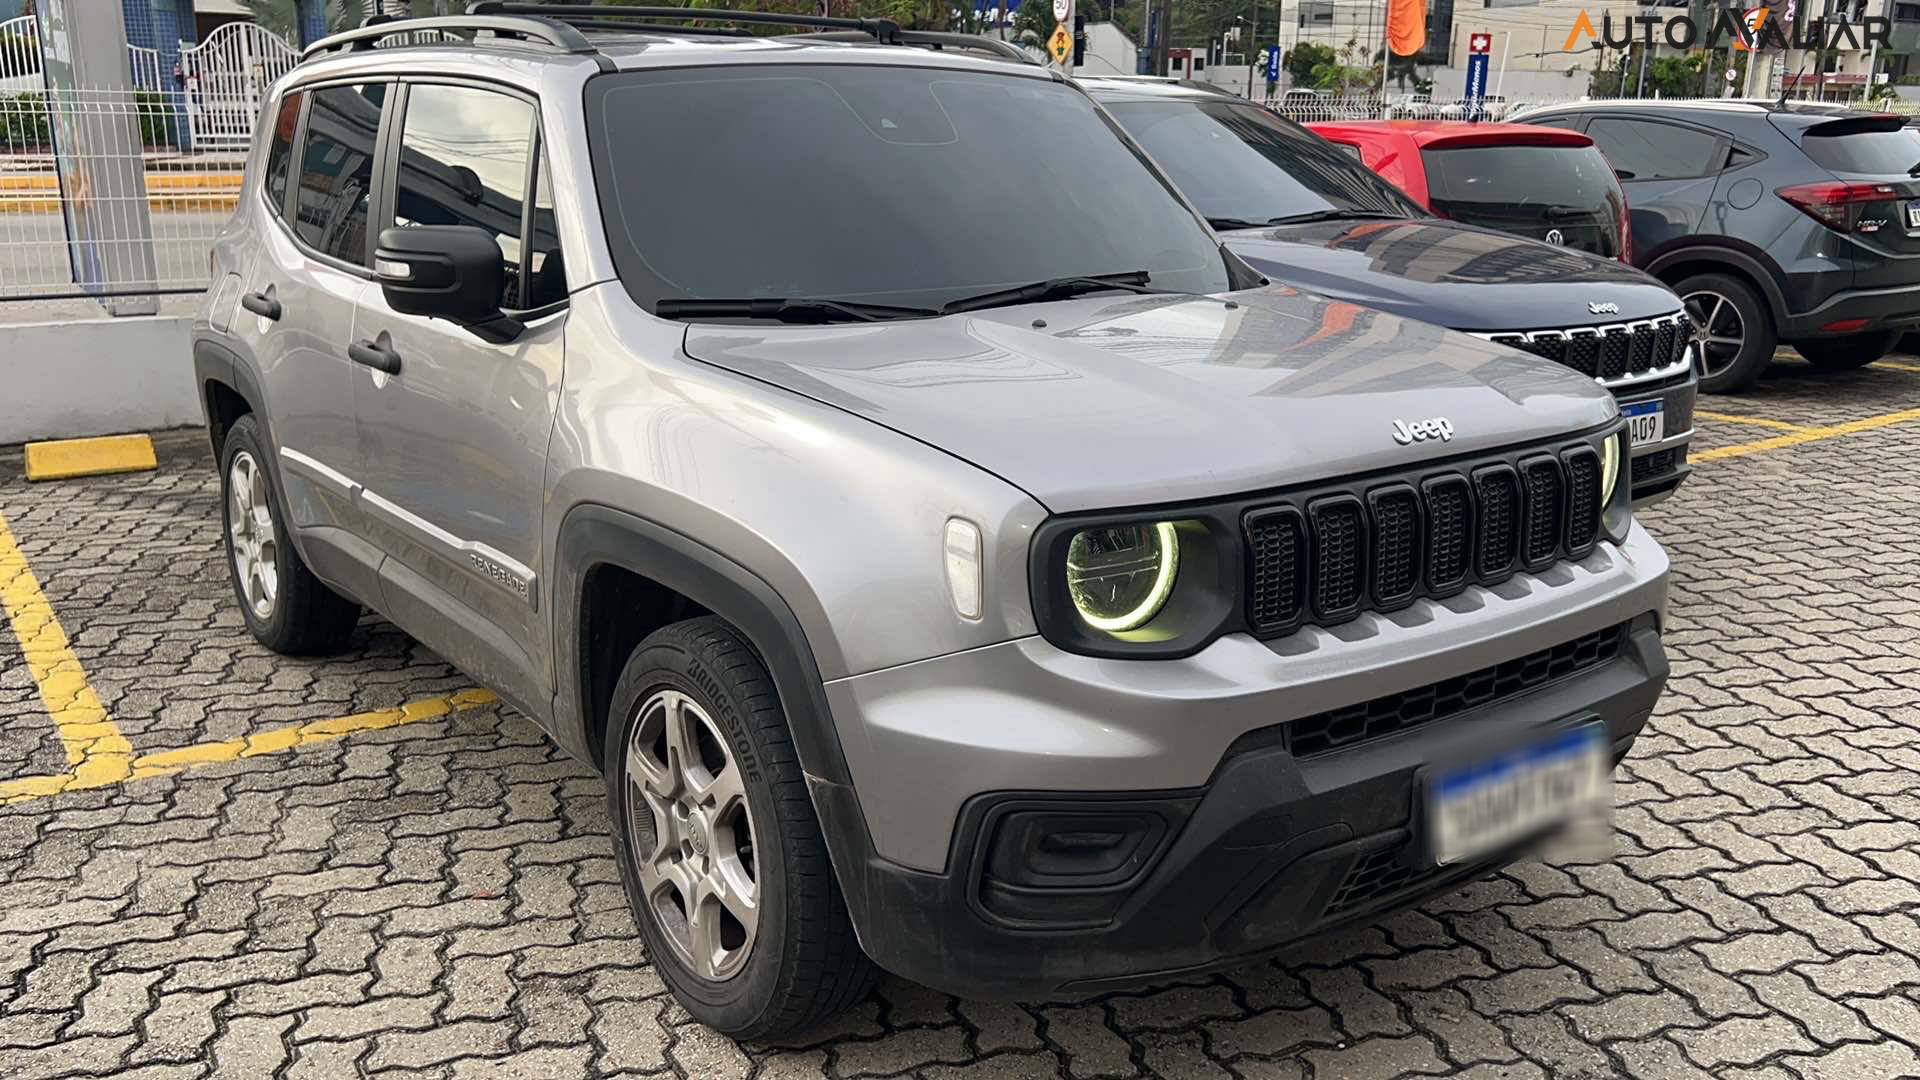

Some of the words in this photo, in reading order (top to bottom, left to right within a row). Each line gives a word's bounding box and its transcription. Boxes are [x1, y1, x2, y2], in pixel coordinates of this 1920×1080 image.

[1588, 301, 1619, 315] Jeep
[1391, 416, 1454, 446] Jeep
[469, 553, 528, 599] RENEGADE
[687, 657, 763, 785] BRIDGESTONE
